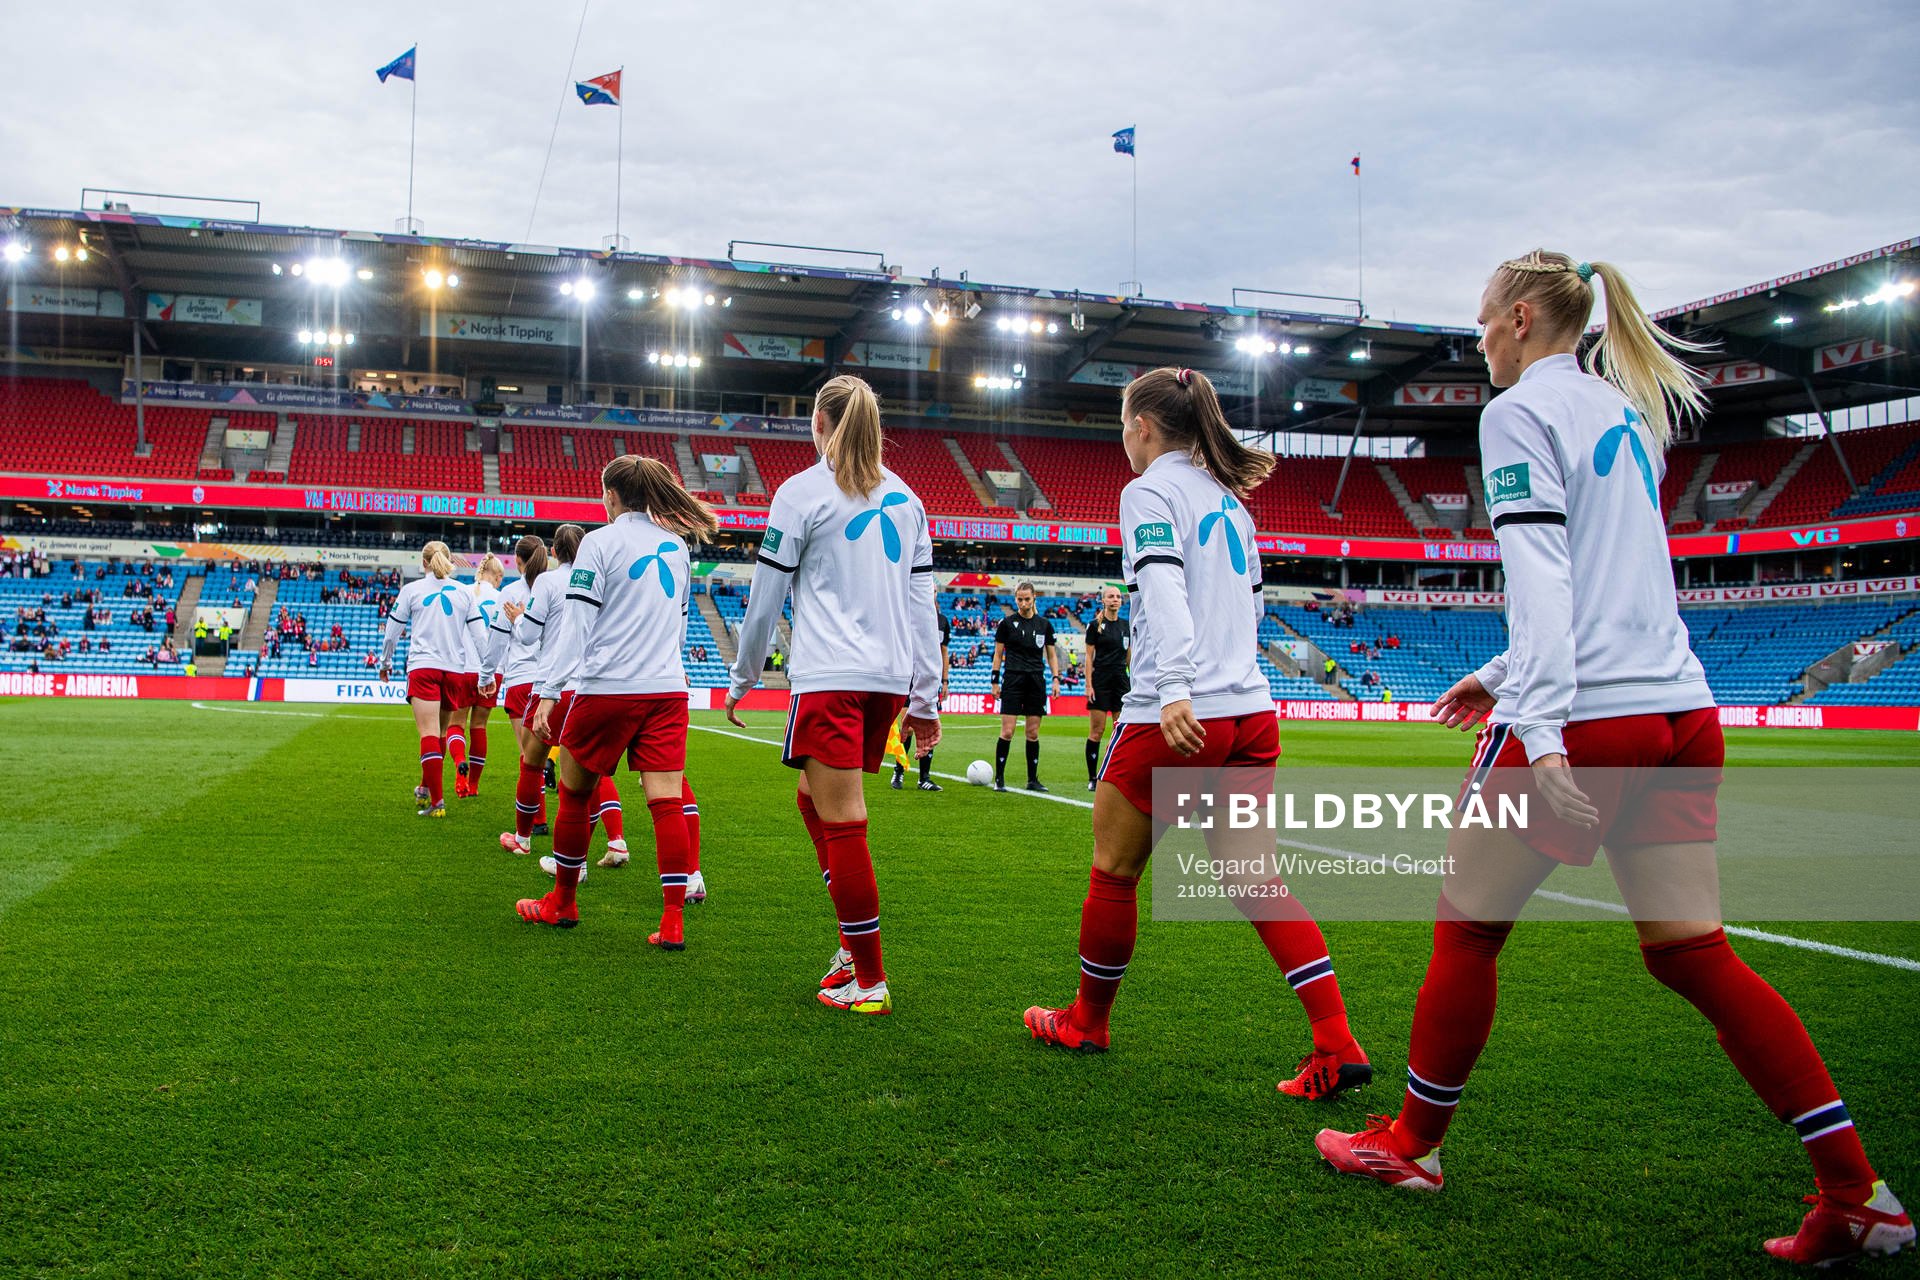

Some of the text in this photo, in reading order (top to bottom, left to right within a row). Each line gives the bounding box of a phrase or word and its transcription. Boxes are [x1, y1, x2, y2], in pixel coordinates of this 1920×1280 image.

[470, 322, 554, 342] Norsk Tipping
[1405, 386, 1479, 404] VG
[412, 401, 460, 412] Norsk Tipping
[65, 484, 144, 501] Norsk Tipping
[304, 491, 417, 513] VM-KVALIFISERING
[1139, 525, 1165, 540] DNB
[1790, 527, 1840, 546] VG
[328, 550, 381, 563] Norsk Tipping
[1772, 586, 1812, 598] VG
[1820, 582, 1858, 595] VG
[1866, 579, 1906, 592] VG
[1384, 593, 1418, 602] VG
[1426, 594, 1465, 603] VG
[1724, 588, 1764, 600] VG
[337, 684, 374, 698] FIFA
